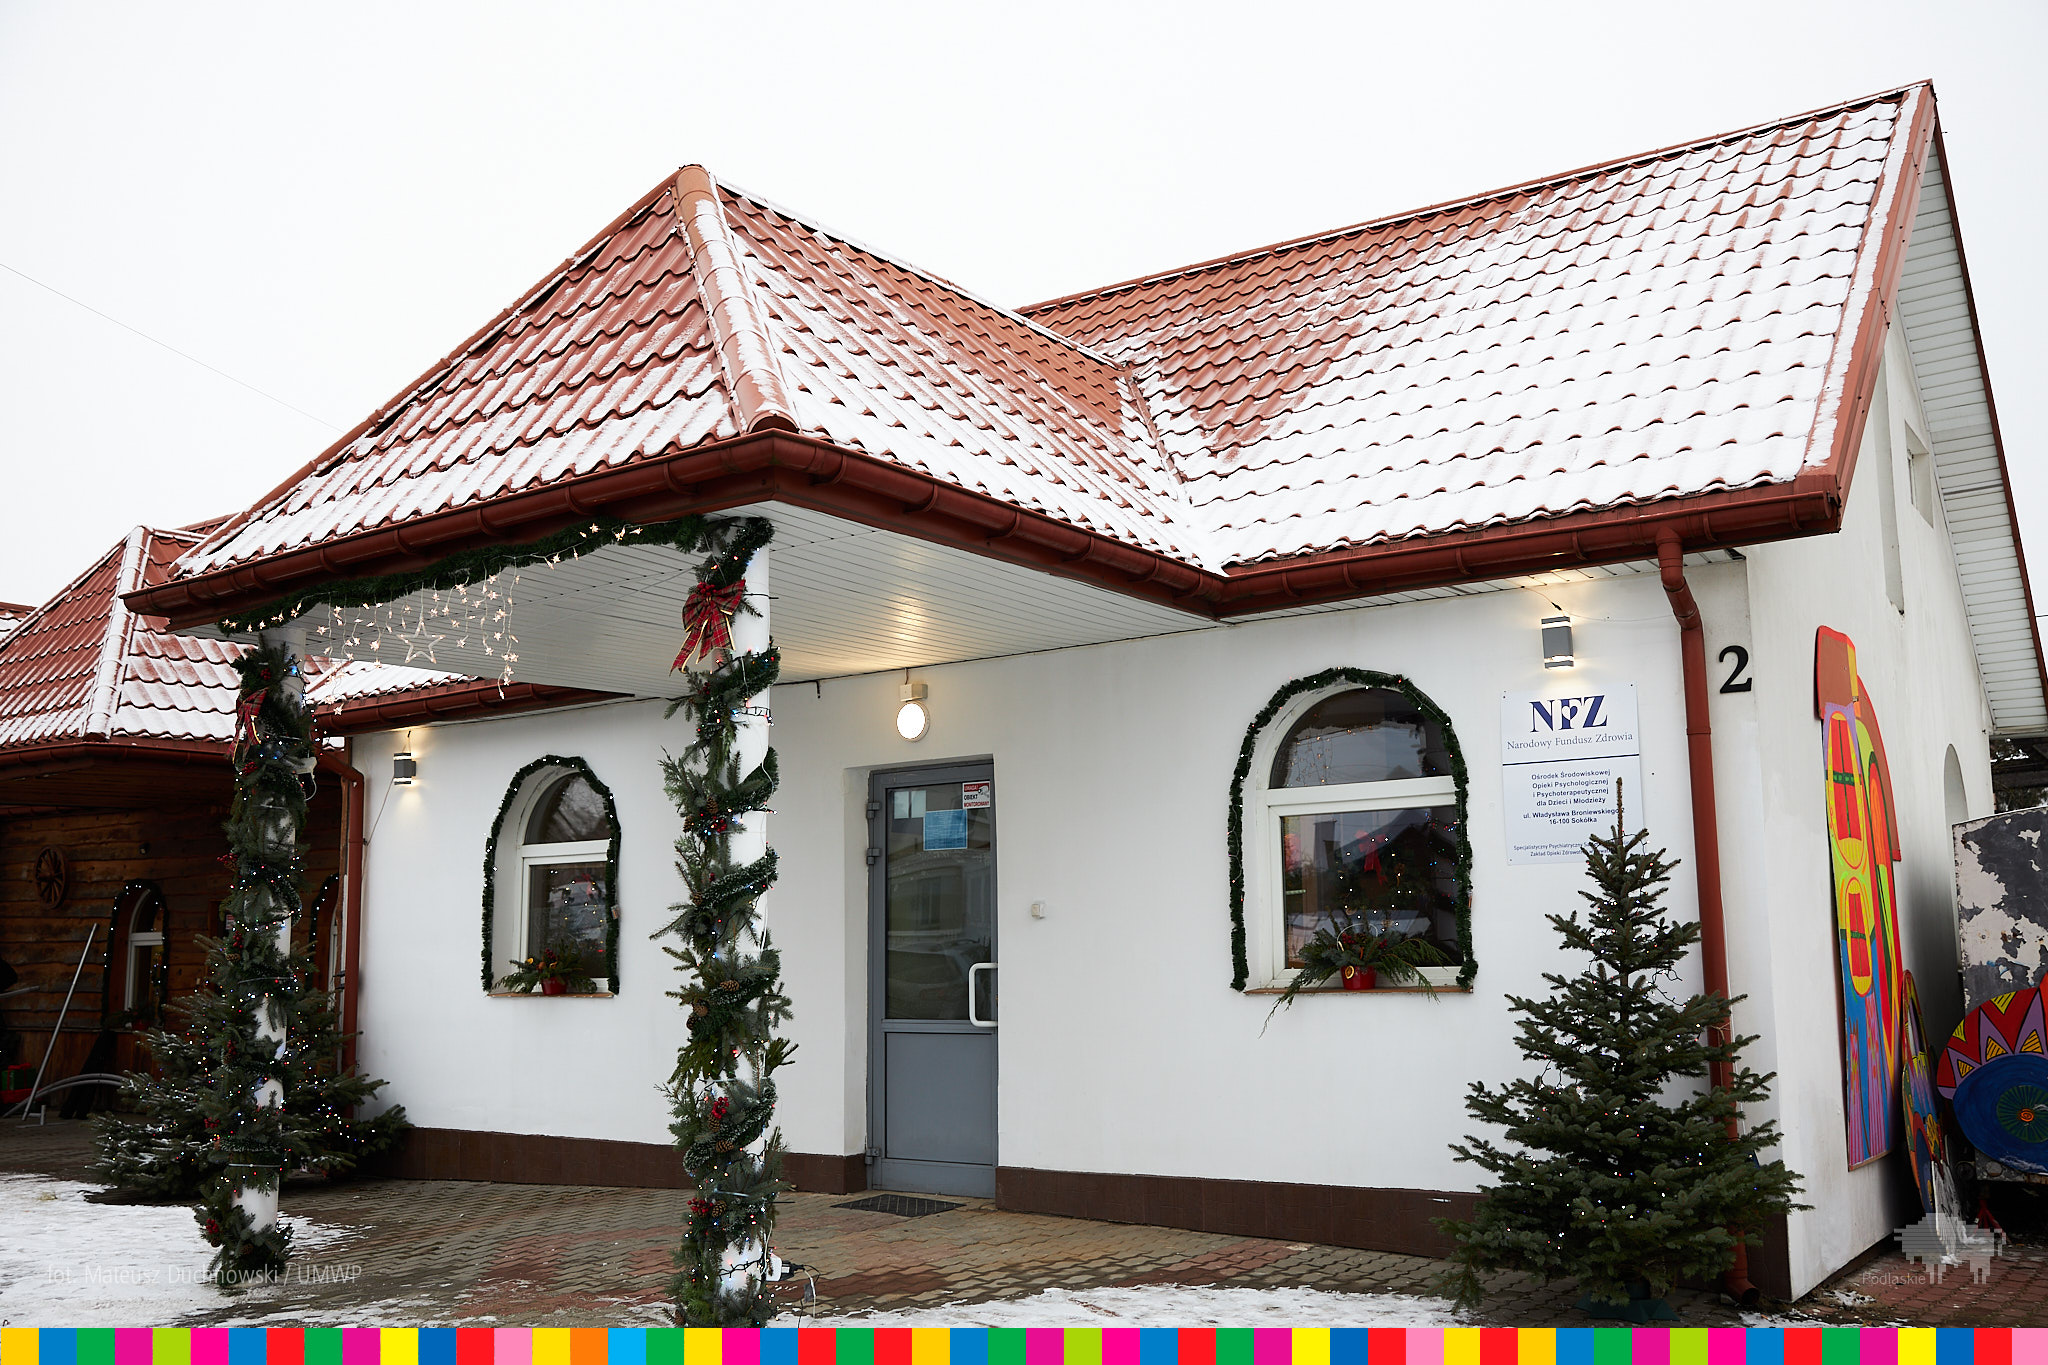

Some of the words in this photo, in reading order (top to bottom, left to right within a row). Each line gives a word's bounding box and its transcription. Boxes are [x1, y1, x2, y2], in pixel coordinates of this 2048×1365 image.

[1718, 645, 1752, 694] 2
[1529, 695, 1608, 733] NFZ
[1507, 739, 1552, 750] Narodowy
[1555, 736, 1592, 746] Fundusz
[1596, 732, 1633, 743] Zdrowia
[1560, 769, 1611, 778] Środowiskowej
[1554, 778, 1609, 788] Psychologicznej
[1536, 788, 1609, 798] Psychoterapeutycznej
[1573, 797, 1606, 805] Młodzieży
[1532, 811, 1570, 819] Władysława
